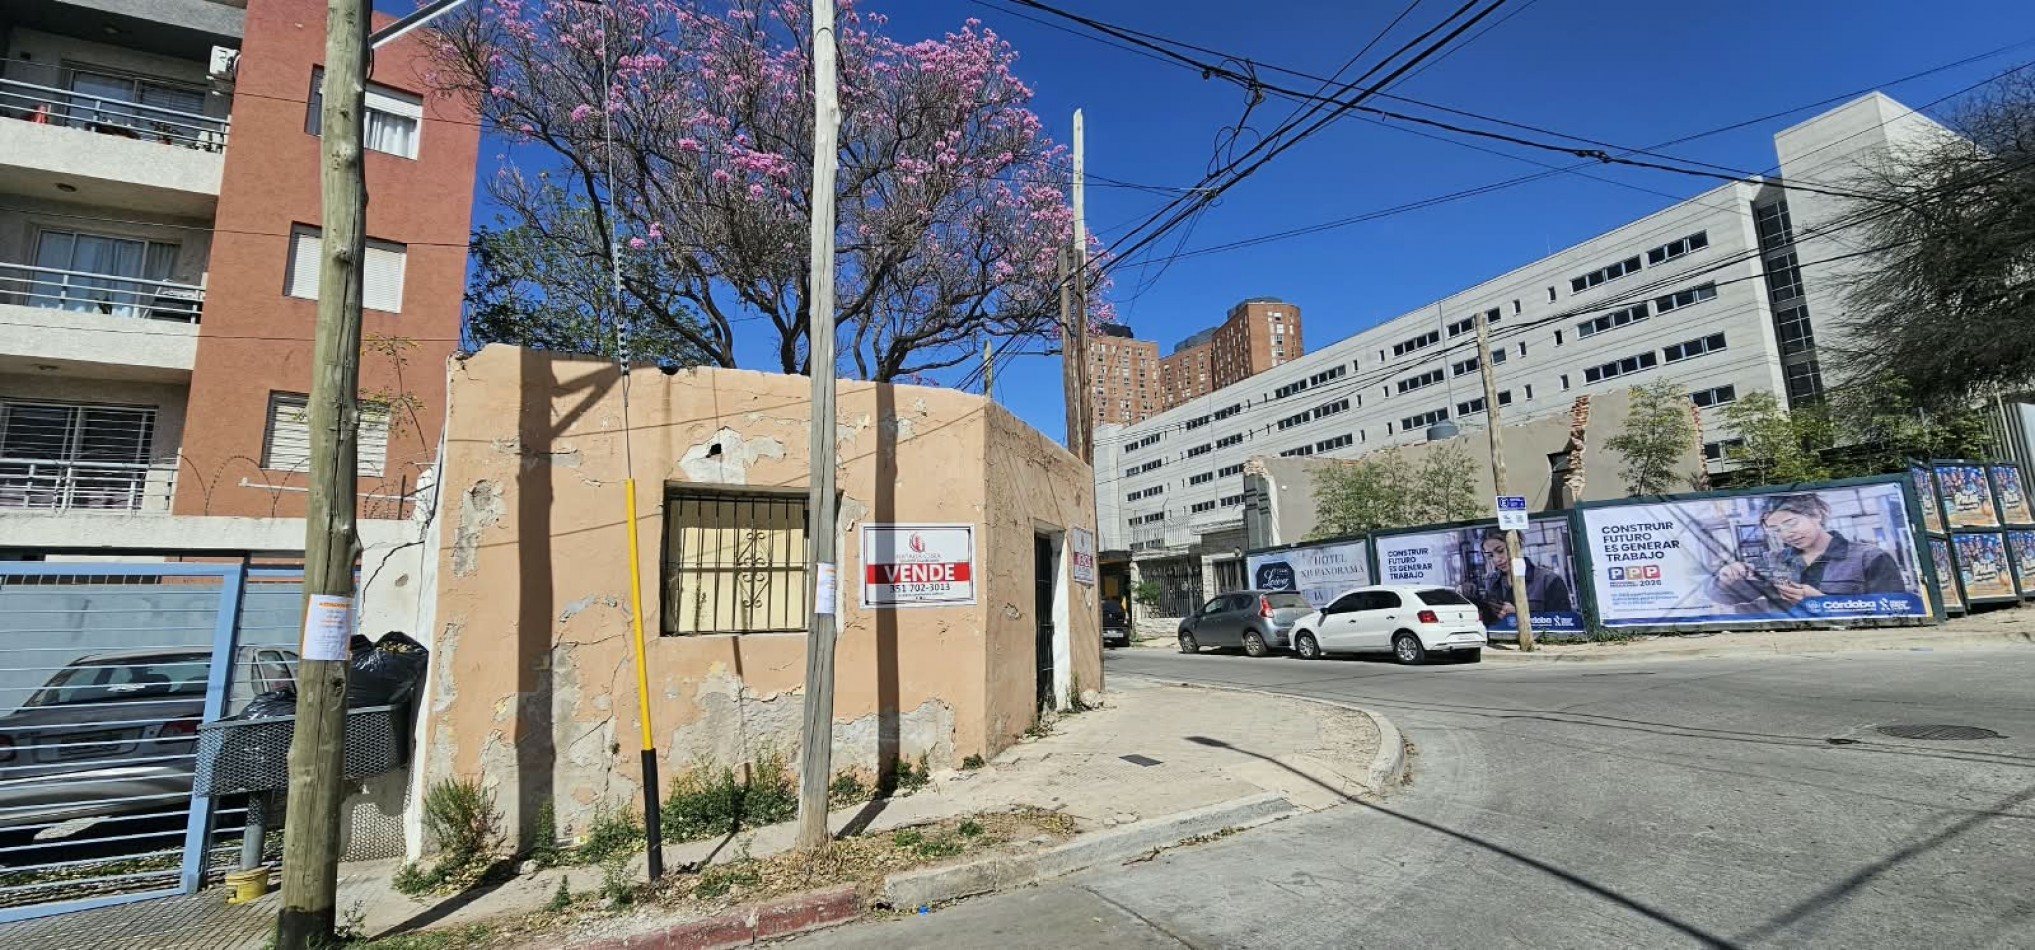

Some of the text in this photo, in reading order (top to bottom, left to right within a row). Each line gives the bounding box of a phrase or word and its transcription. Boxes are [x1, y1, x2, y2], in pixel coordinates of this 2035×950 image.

[1601, 522, 1674, 534] CONSTRUIR
[1603, 533, 1652, 543] FUTURO
[1604, 540, 1680, 552] ES GENERAR
[1388, 548, 1429, 557] CONSTRUIR
[1606, 551, 1665, 562] TRABAJO
[1314, 554, 1346, 566] HOTEL
[1388, 557, 1416, 565] FUTURO
[1314, 564, 1365, 577] PANORAMA
[1398, 563, 1432, 572] GENERAR
[884, 563, 955, 583] VENDE
[1389, 571, 1424, 580] TRABAJO
[889, 583, 951, 593] 351 702-3013
[1640, 579, 1662, 587] 2026
